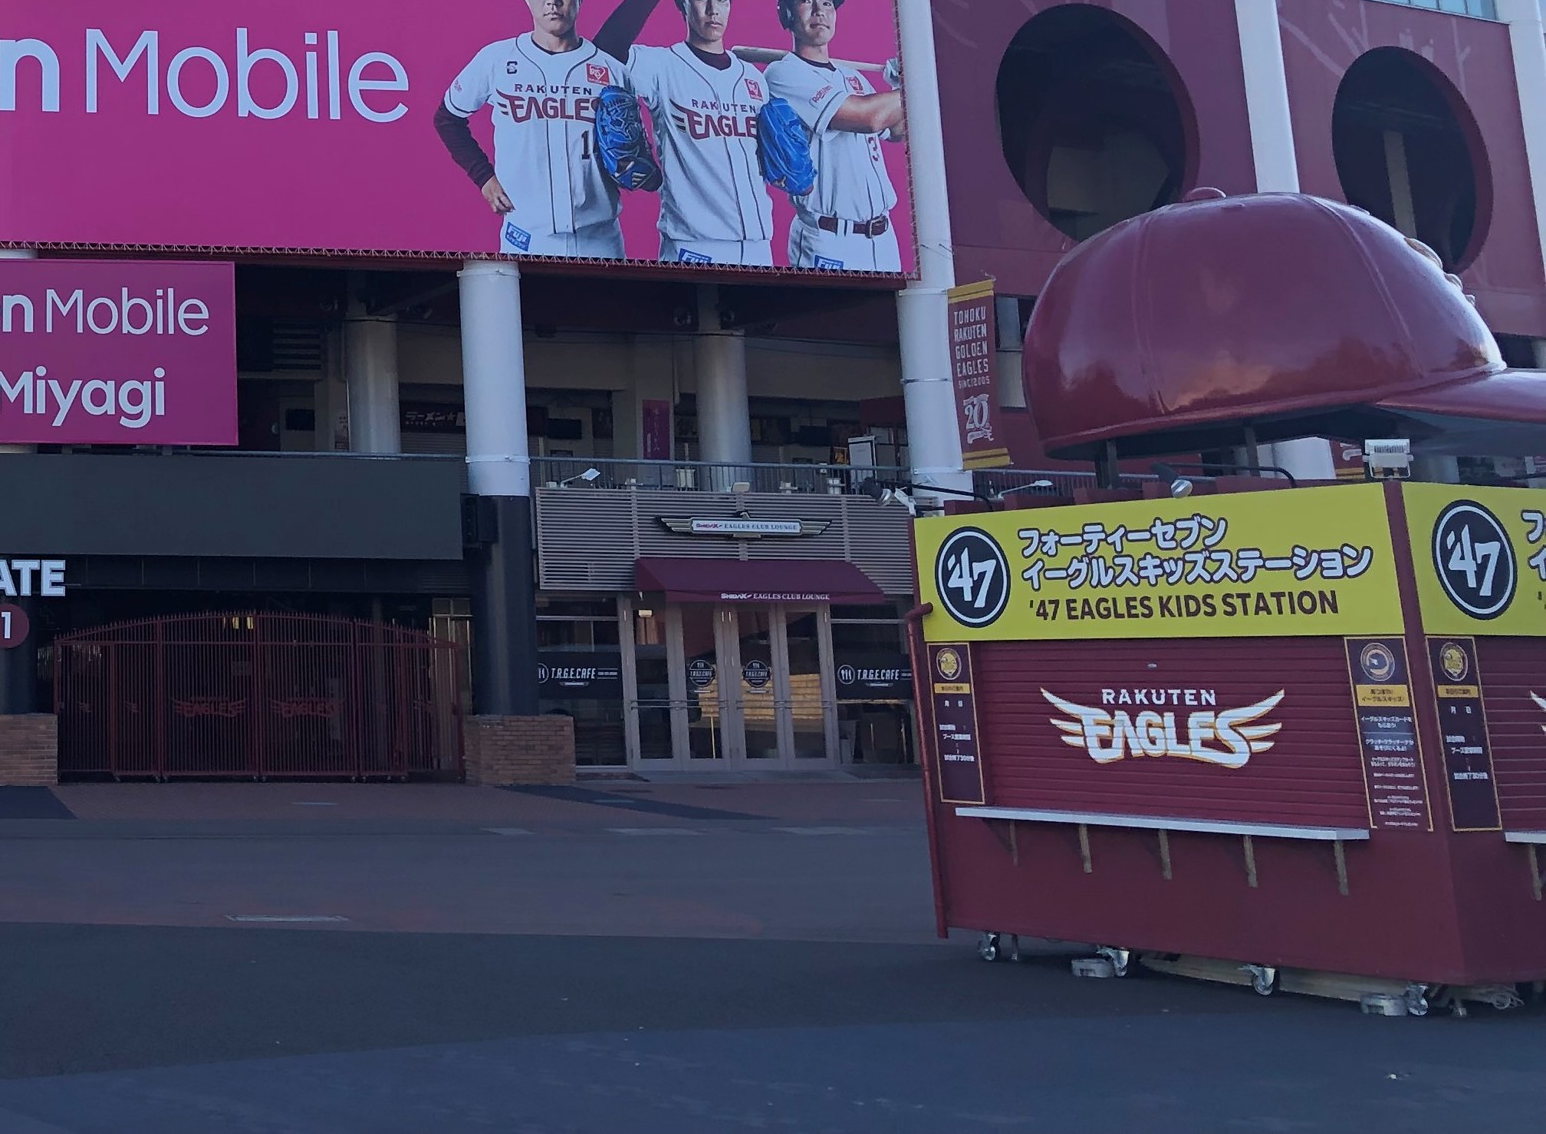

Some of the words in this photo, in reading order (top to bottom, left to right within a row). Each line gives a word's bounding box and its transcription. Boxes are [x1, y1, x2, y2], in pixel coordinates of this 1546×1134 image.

[85, 27, 410, 123] Mobile
[514, 83, 592, 95] RAKUTEN
[691, 98, 756, 114] RAKUTEN
[46, 287, 210, 336] Mobile
[954, 306, 986, 326] TOHOKU
[954, 323, 987, 343] RAKUTEN
[955, 340, 988, 360] GOLDEN
[957, 358, 989, 377] EAGLES
[1018, 514, 1228, 558] フォーティーセブン
[1021, 543, 1373, 591] イーグルスキッズステーション
[1066, 597, 1154, 620] EAGLES
[1158, 594, 1217, 618] KIDS
[1221, 590, 1339, 617] STATION
[0, 611, 12, 639] 1
[1102, 688, 1217, 706] RAKUTEN
[1054, 699, 1269, 769] EAGLES
